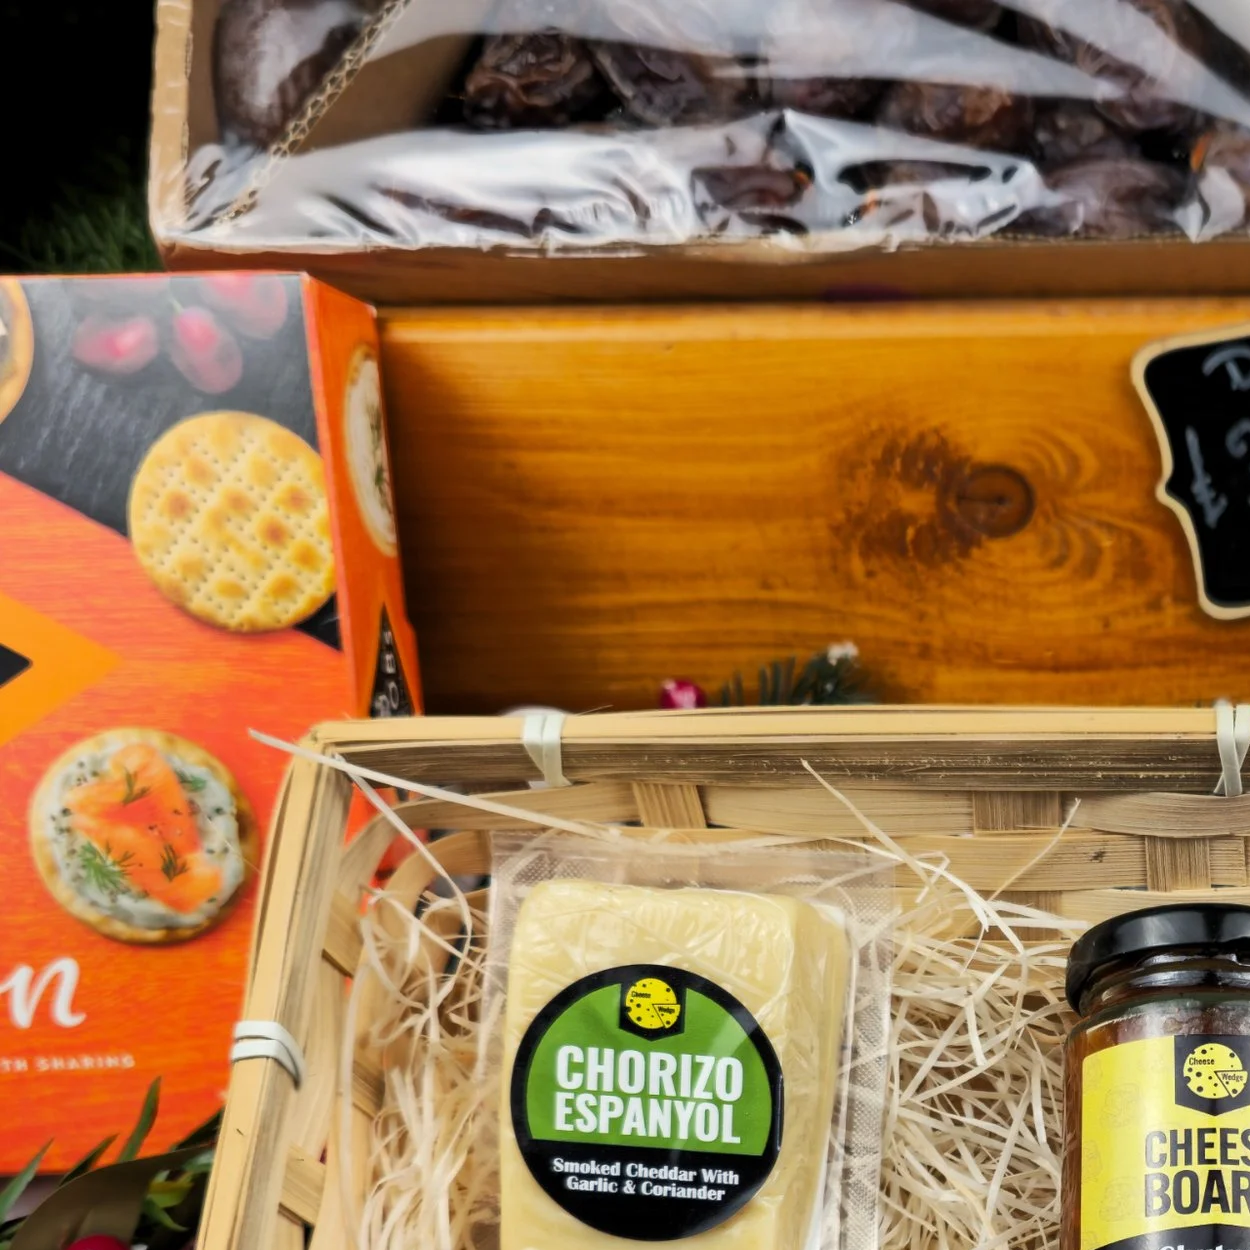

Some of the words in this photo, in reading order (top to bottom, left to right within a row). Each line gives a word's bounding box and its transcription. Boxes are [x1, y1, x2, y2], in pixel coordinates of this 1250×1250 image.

[35, 1052, 136, 1072] SHARING
[556, 1045, 744, 1102] CHORIZO
[1189, 1057, 1215, 1066] Cheese
[1221, 1073, 1243, 1083] Wedge
[554, 1092, 742, 1145] ESPANYOL
[553, 1158, 621, 1177] Smoked
[626, 1163, 697, 1182] Cheddar
[702, 1168, 740, 1186] With
[566, 1176, 618, 1194] Garlic
[623, 1180, 636, 1194] &
[641, 1181, 726, 1201] Coriander
